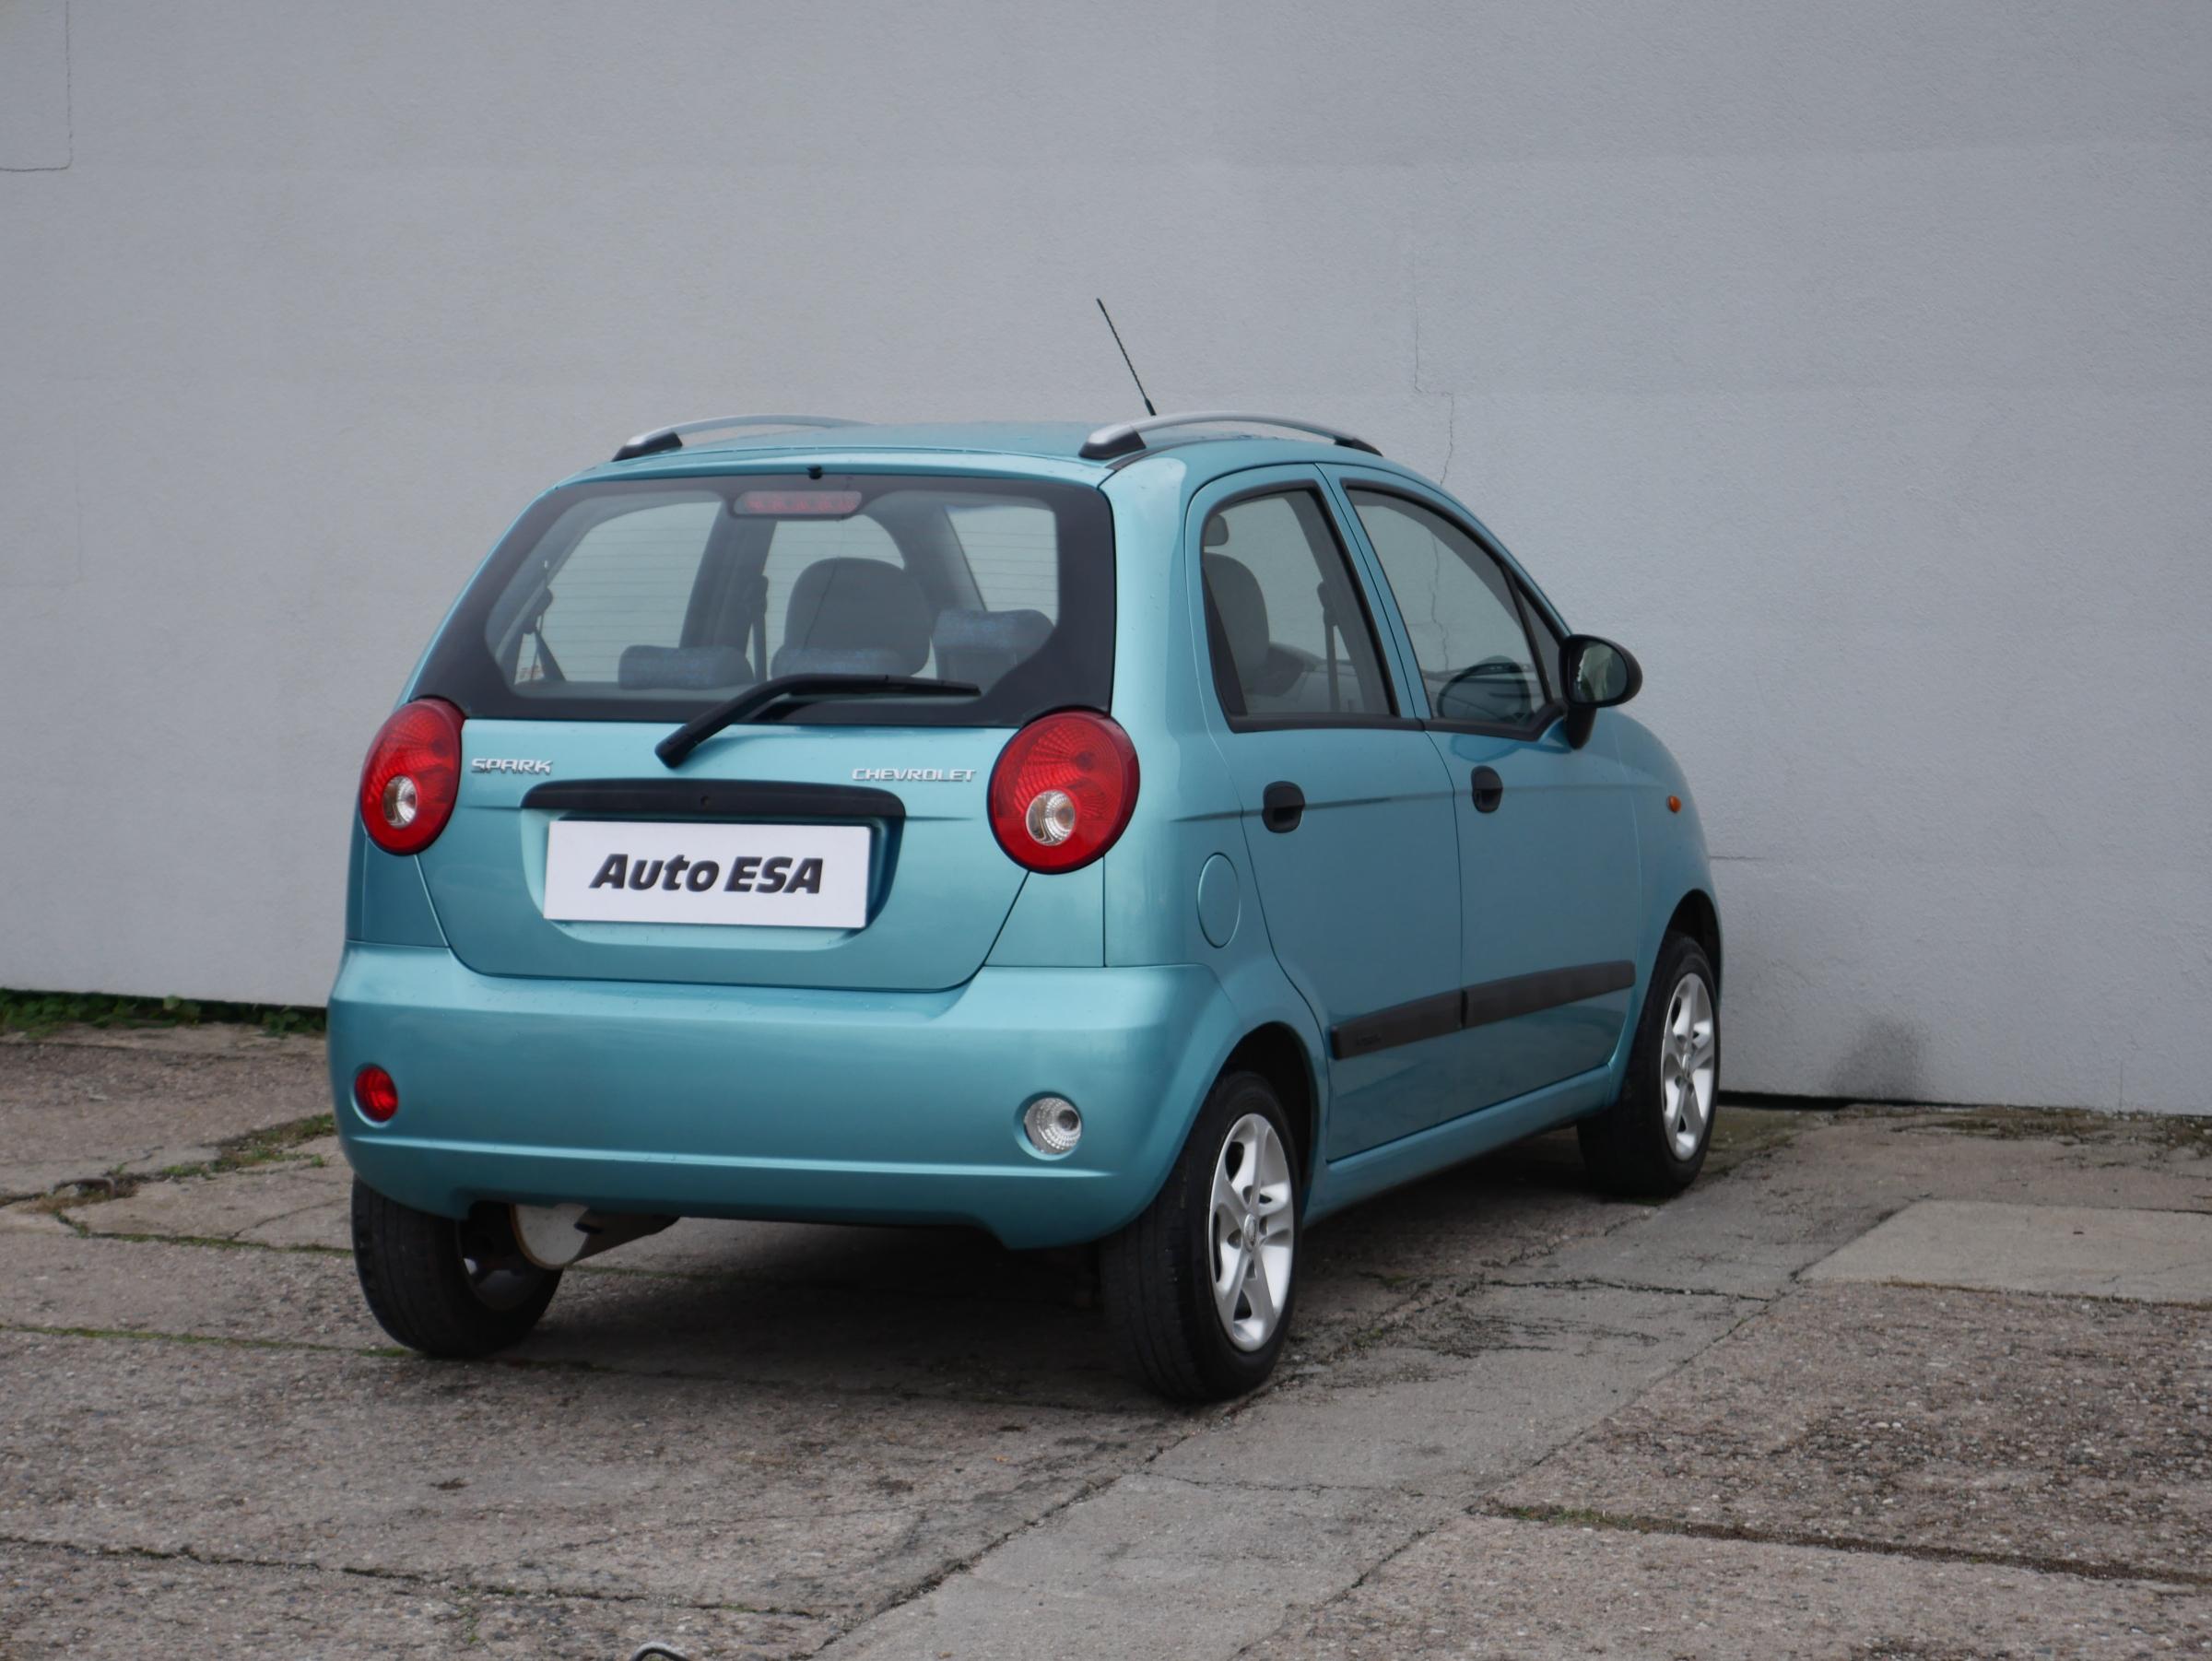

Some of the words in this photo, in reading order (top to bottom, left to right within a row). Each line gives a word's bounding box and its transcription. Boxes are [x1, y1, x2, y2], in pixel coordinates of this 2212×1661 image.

[471, 758, 552, 774] SPARK
[852, 768, 976, 782] CHEVROLET
[588, 854, 720, 892] Auto
[724, 856, 823, 894] ESA
